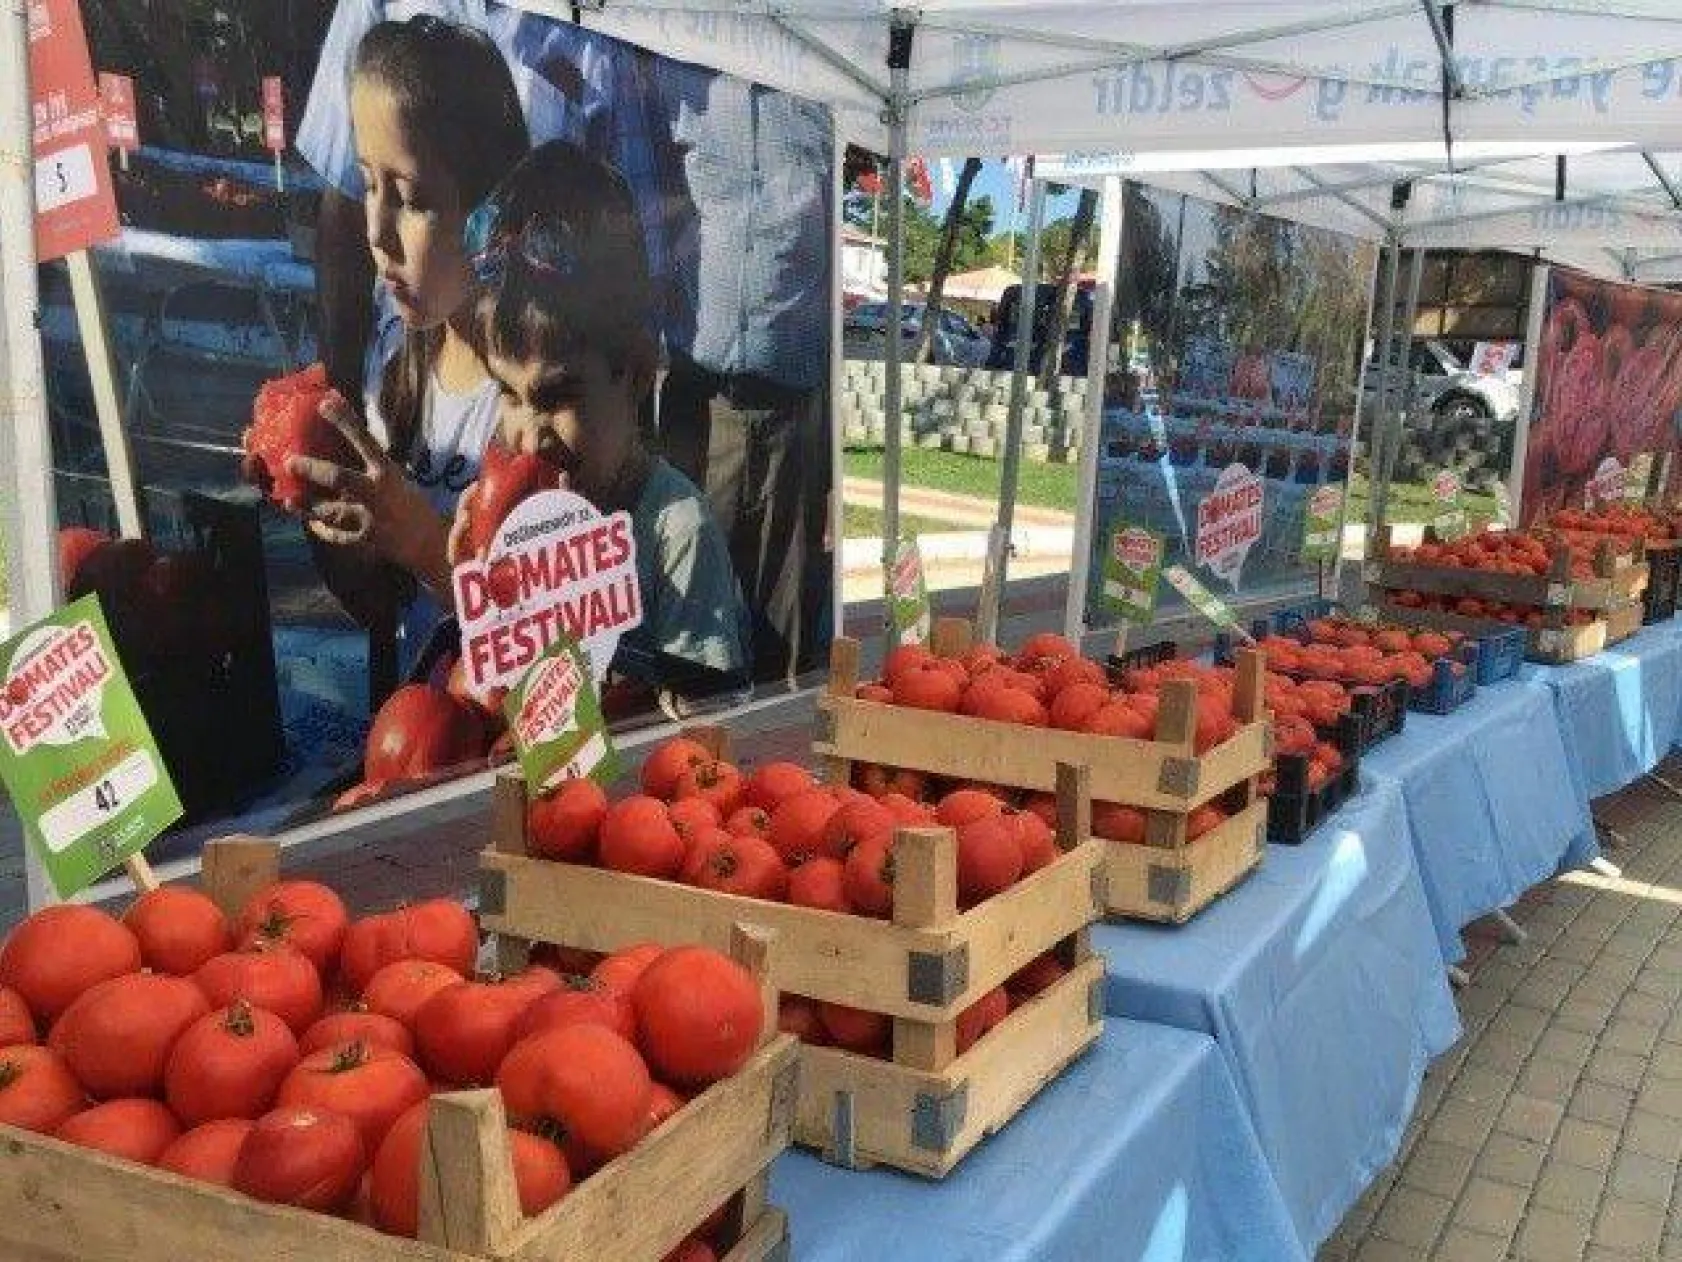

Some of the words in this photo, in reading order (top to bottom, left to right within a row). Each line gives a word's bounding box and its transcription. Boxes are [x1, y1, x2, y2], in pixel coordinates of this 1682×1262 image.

[459, 520, 631, 621] DOMATES
[0, 625, 94, 721] DOMATES
[95, 781, 119, 812] 42
